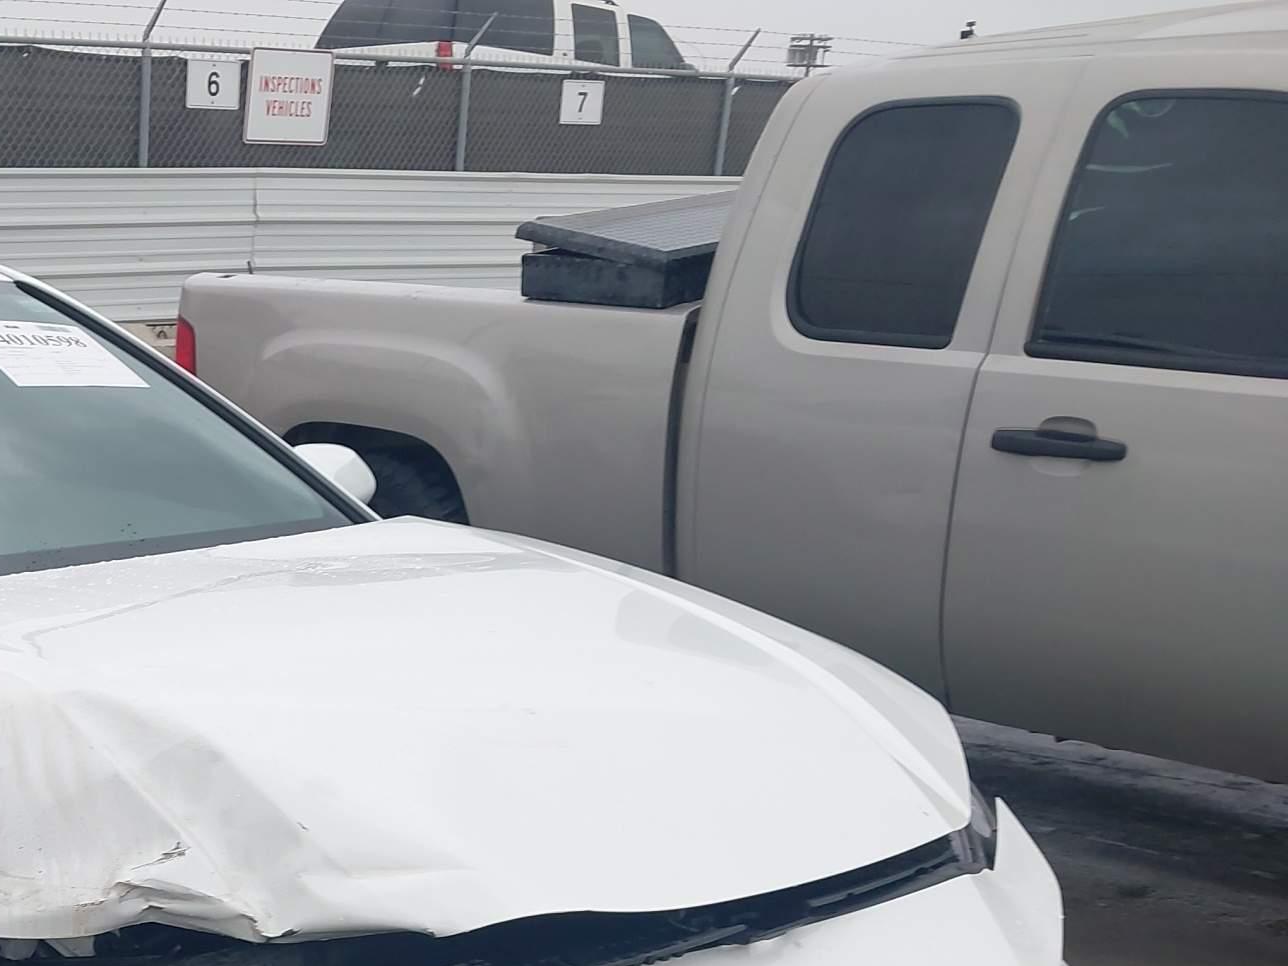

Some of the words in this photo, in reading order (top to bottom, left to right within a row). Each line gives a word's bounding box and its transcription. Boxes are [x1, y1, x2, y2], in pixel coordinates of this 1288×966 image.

[207, 71, 220, 97] 6
[259, 75, 323, 95] INSPECTIONS
[266, 100, 312, 117] VEHICLES
[578, 91, 588, 113] 7
